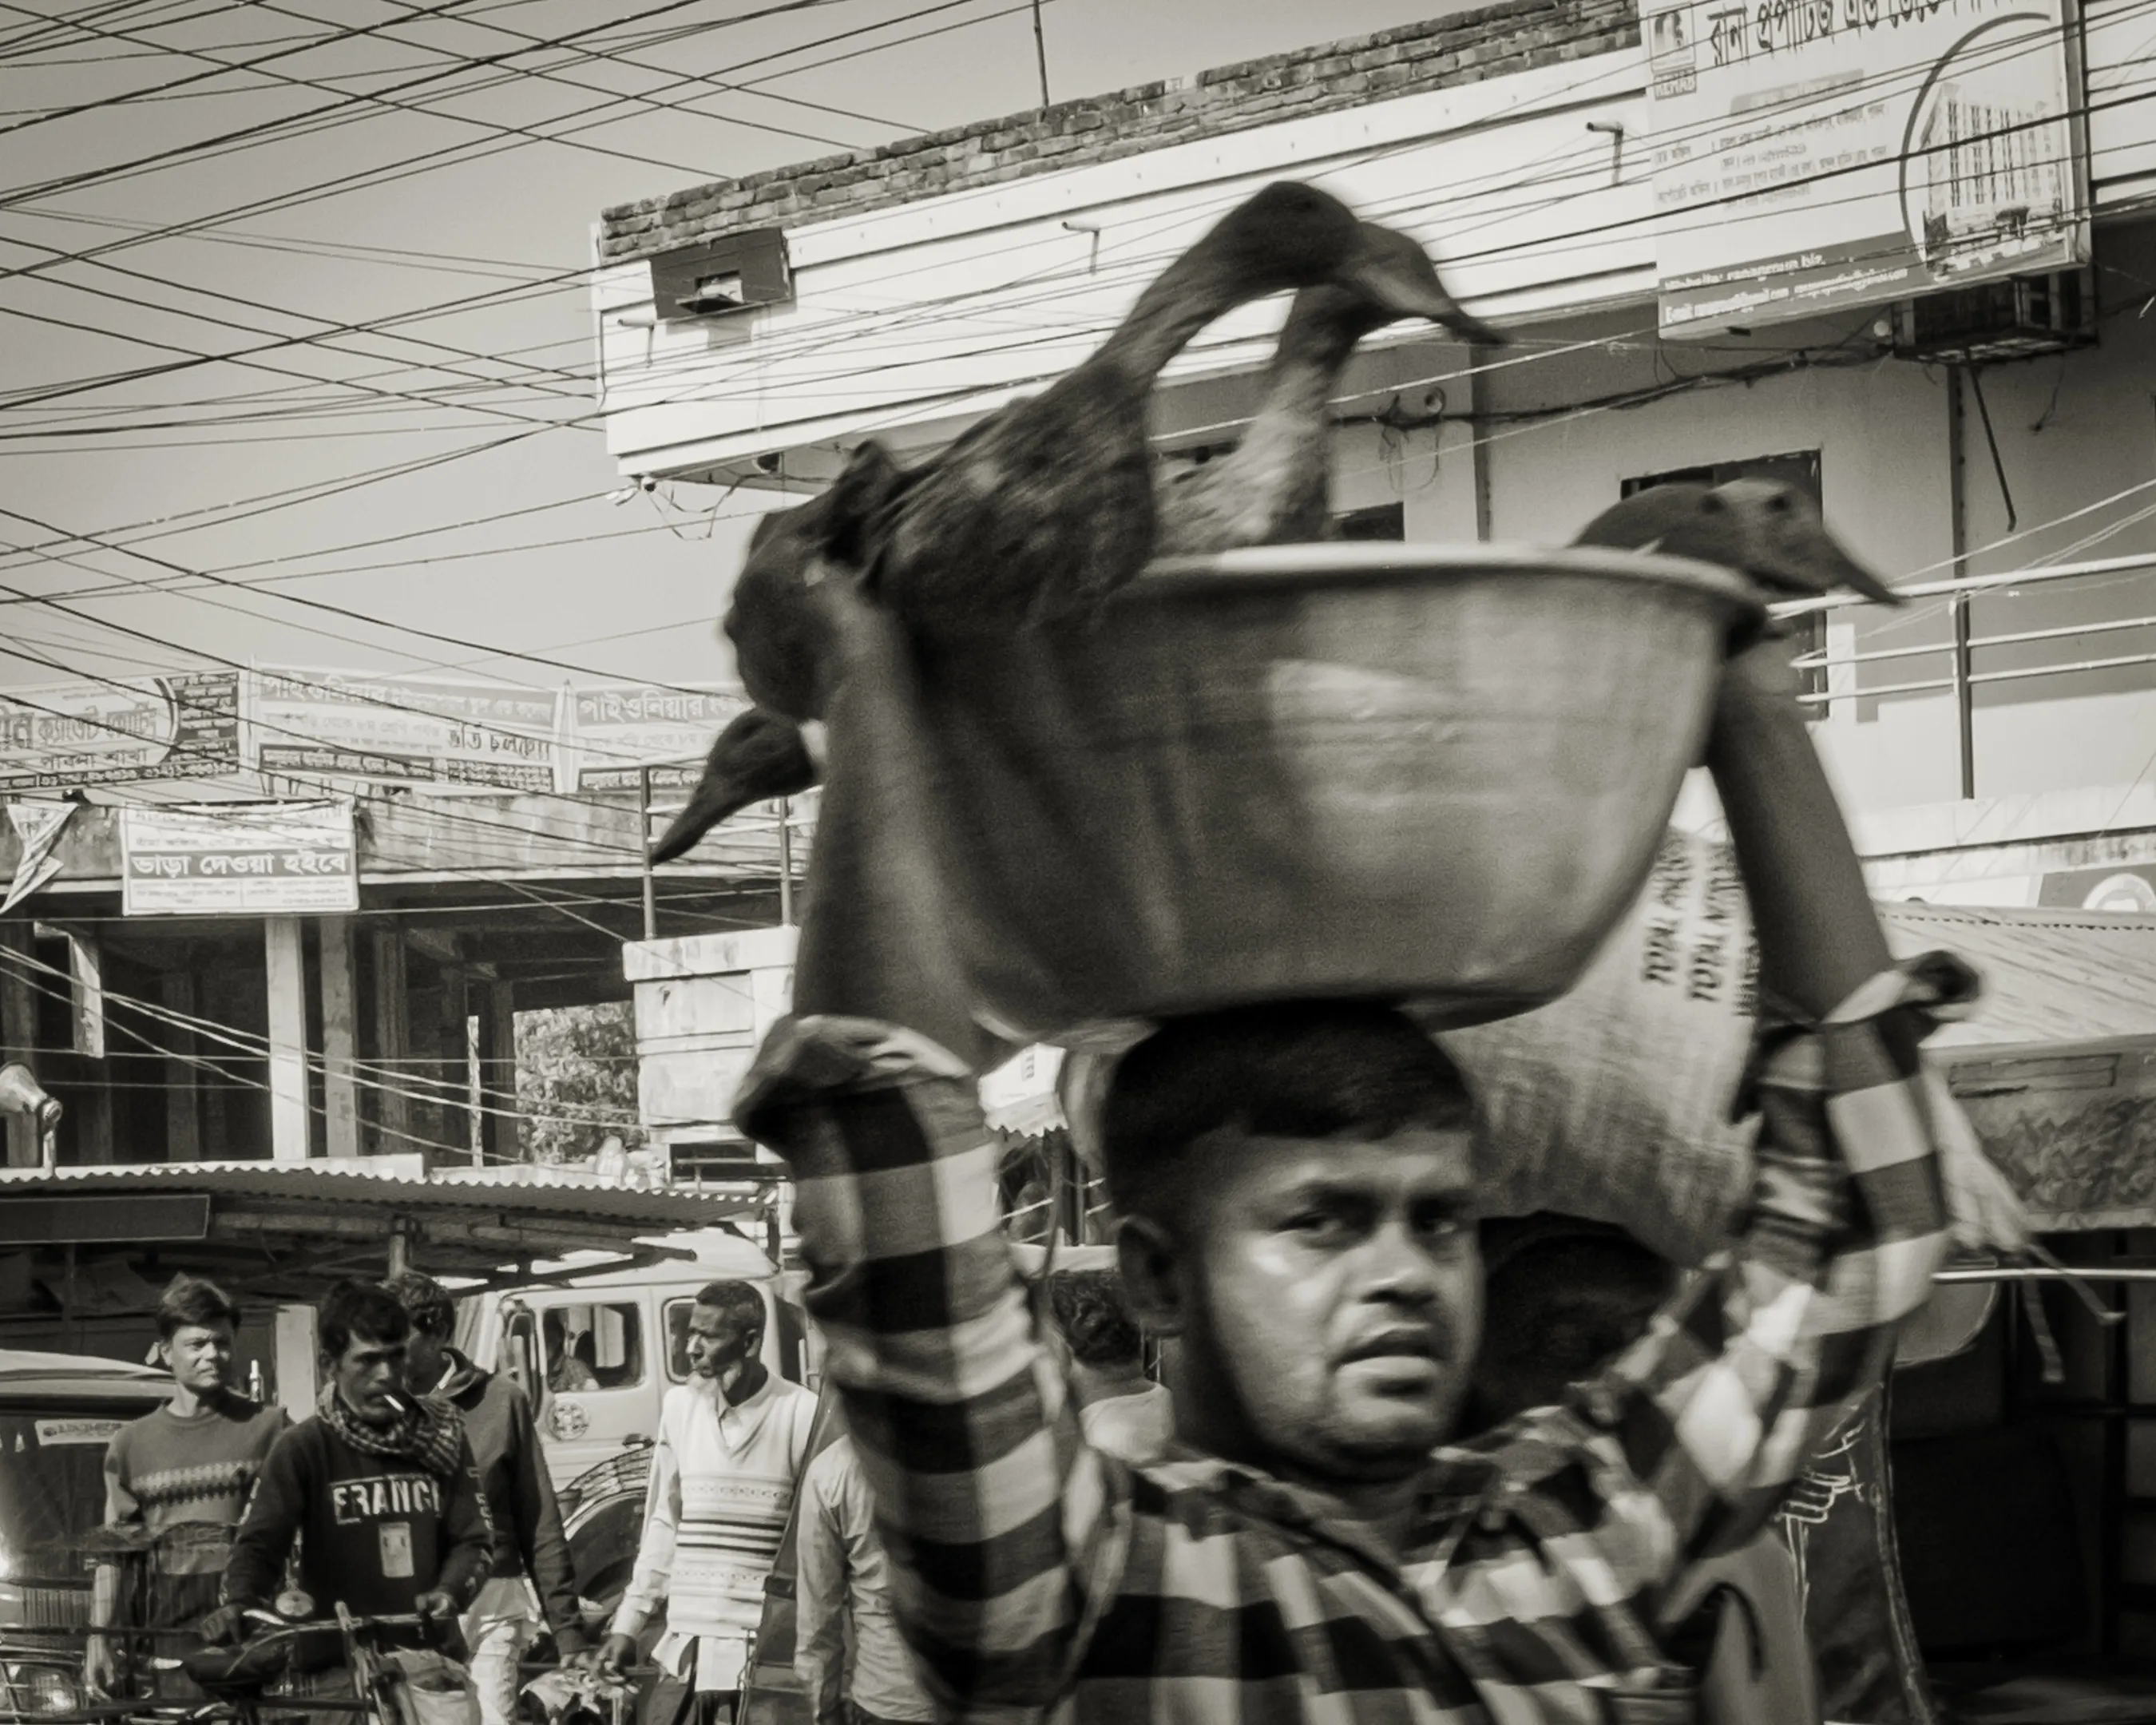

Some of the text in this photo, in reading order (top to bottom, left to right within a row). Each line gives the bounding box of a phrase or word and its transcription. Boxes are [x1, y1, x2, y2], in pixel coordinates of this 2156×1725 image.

[131, 849, 347, 878] ভাড়া দেওয়া হইবে
